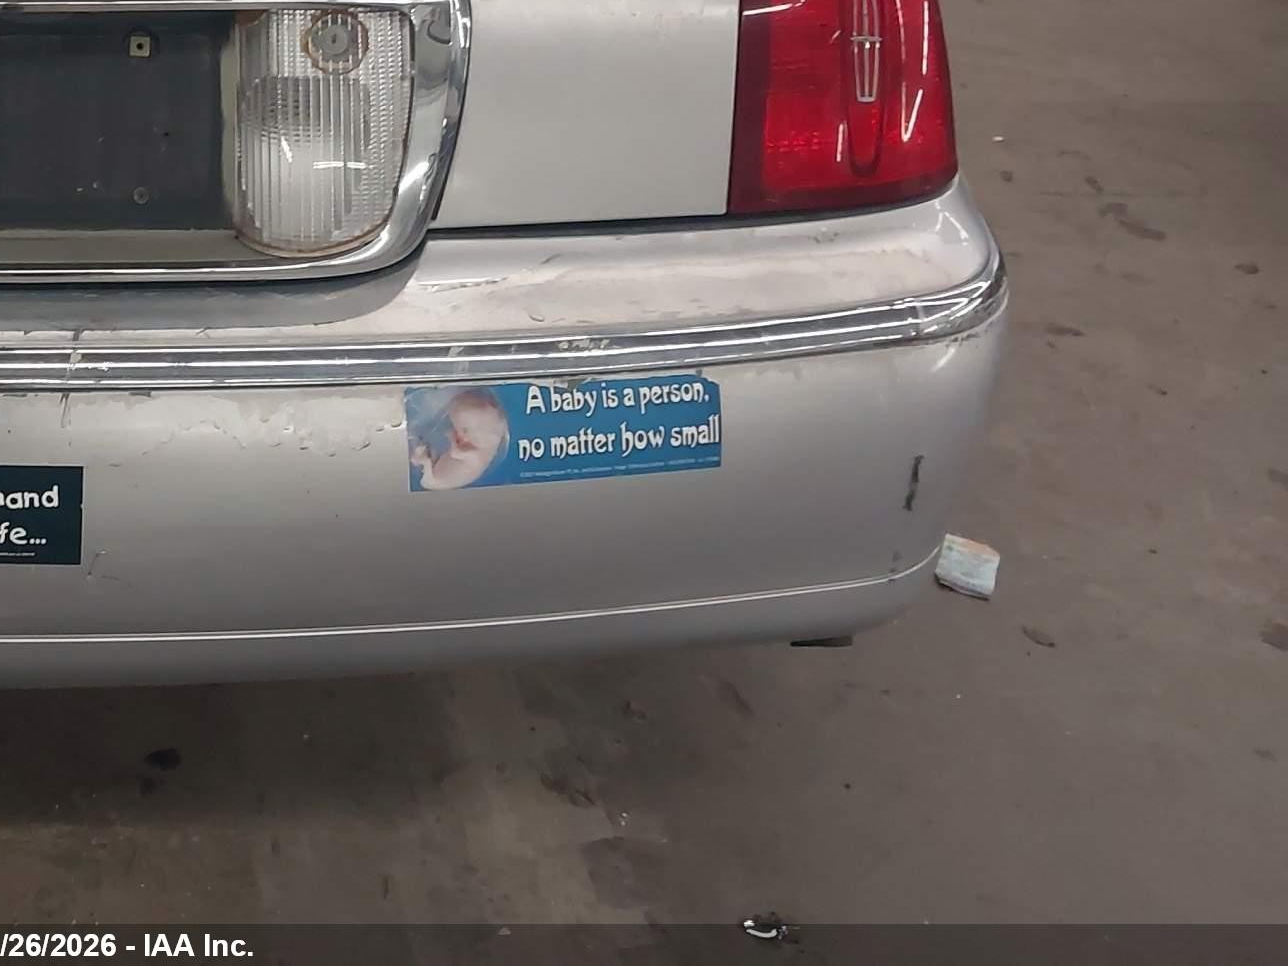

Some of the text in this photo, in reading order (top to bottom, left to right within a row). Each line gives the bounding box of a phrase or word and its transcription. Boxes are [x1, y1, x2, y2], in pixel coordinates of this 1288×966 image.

[526, 386, 545, 414] A
[550, 386, 597, 417] baby
[601, 382, 619, 409] is
[623, 386, 636, 408] a
[518, 414, 721, 462] no matter how small
